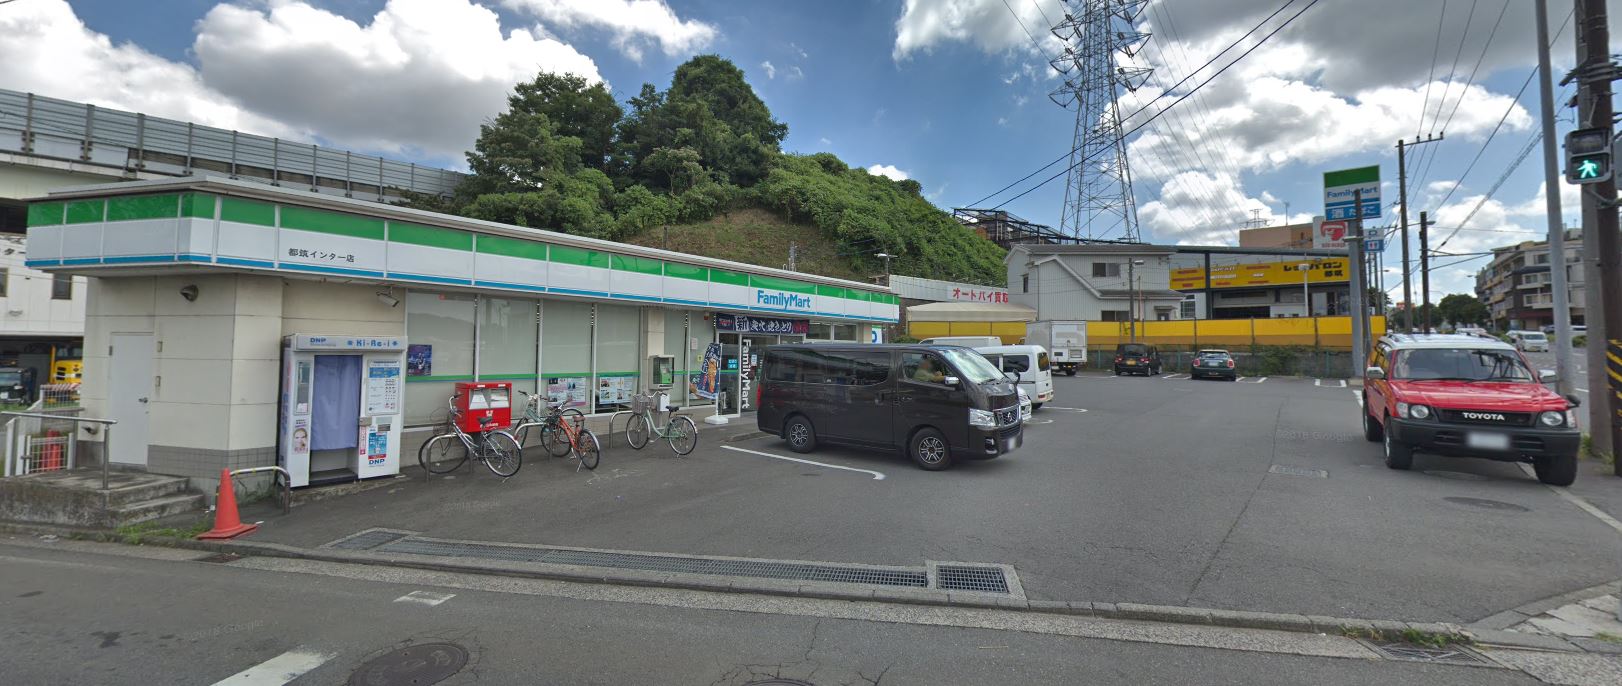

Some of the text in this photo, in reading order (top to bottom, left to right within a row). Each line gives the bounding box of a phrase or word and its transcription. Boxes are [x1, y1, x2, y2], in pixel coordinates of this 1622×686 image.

[288, 248, 355, 263] 都筑インター店
[1283, 261, 1343, 272] レッバロン
[757, 289, 811, 310] FamilyMart
[952, 287, 1009, 304] オートバイ買取
[741, 339, 752, 409] FamilyMart
[1462, 411, 1505, 421] TOYOTA
